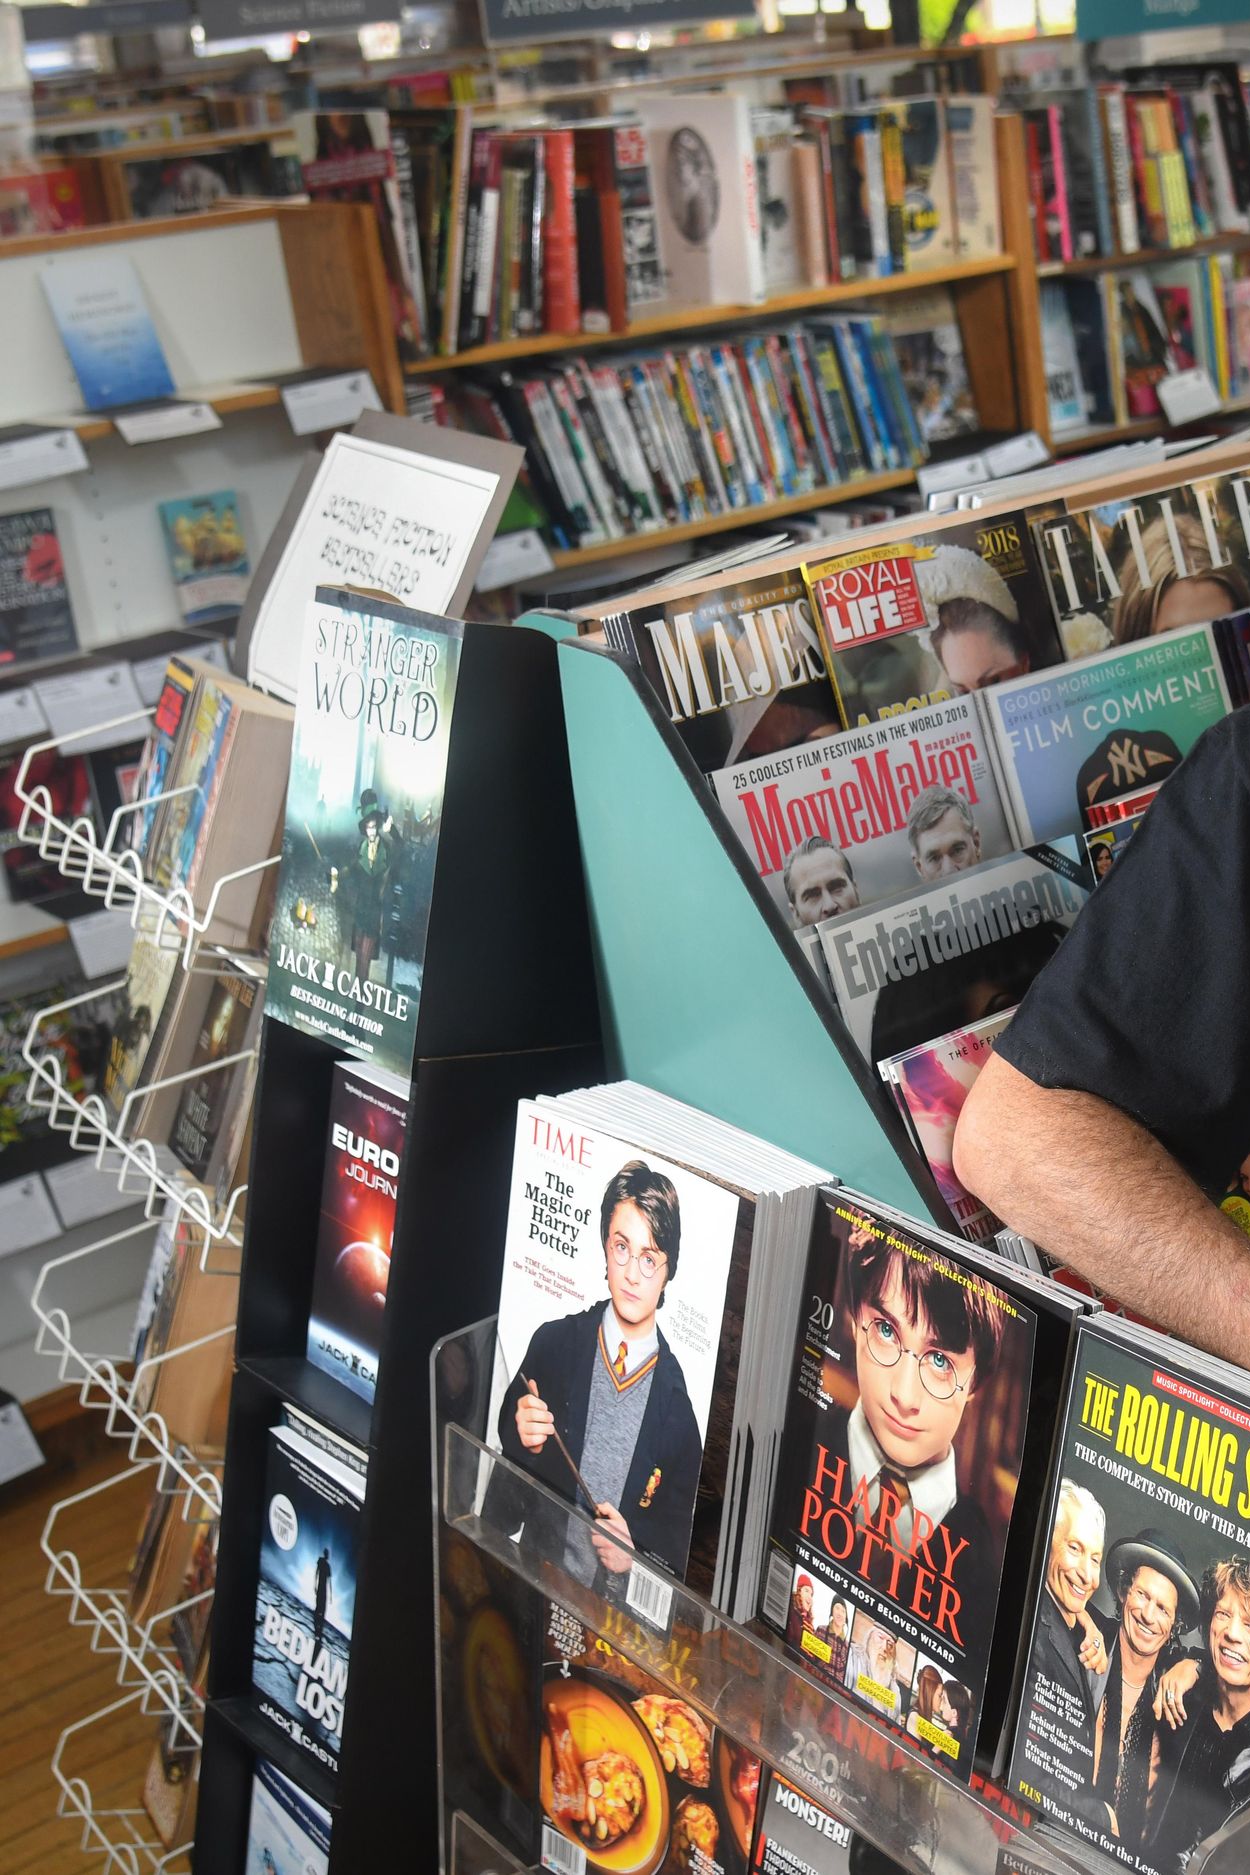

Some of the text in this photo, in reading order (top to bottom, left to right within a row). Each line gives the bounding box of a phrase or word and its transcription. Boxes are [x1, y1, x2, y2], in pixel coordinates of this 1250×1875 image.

[976, 527, 1021, 558] 2018
[817, 557, 912, 606] ROYAL
[825, 590, 904, 644] LIFE
[315, 618, 437, 688] STRANGER
[314, 662, 438, 742] WORLD
[1004, 686, 1051, 714] GOOD
[1005, 714, 1074, 753] FILM
[1083, 665, 1217, 732] COMMENT
[1008, 712, 1035, 727] SPIKE
[732, 704, 969, 791] 25 COOLEST FILM FESTIVALS IN THE WORLD 2018
[924, 731, 973, 753] magazine
[738, 741, 981, 878] MovieMaker
[833, 869, 1079, 999] Entertainment
[276, 943, 410, 1022] JACK CASTLE
[347, 1008, 384, 1037] AUTHOR
[948, 1045, 969, 1062] THE
[528, 1114, 595, 1169] TIME
[545, 1170, 575, 1200] The
[524, 1182, 593, 1227] Magic of
[531, 1203, 580, 1242] Harry
[528, 1222, 579, 1260] Potter
[541, 1261, 557, 1277] Goes
[835, 1206, 1019, 1319] ANNIVERSARY COLLECTOR'S EDITION
[807, 1322, 823, 1338] Years
[808, 1294, 834, 1331] 20
[318, 1338, 349, 1366] JACK
[805, 1331, 842, 1362] Enchantment
[800, 1367, 818, 1385] Guide
[817, 1385, 834, 1404] Books
[1155, 1375, 1178, 1392] MUSIC
[808, 1390, 829, 1412] Movies
[1081, 1376, 1119, 1437] THE
[1115, 1383, 1240, 1511] ROLLING
[1074, 1441, 1098, 1467] THE
[1097, 1455, 1157, 1498] COMPLETE
[1155, 1485, 1195, 1515] STORY
[1193, 1504, 1212, 1525] OF
[1211, 1512, 1236, 1539] THE
[812, 1443, 971, 1584] HARRY
[799, 1487, 965, 1648] POTTER
[551, 1611, 585, 1634] BACON
[795, 1543, 956, 1665] THE WORLD'S MOST BELOVED WIZARD
[547, 1629, 587, 1654] POTATO
[553, 1640, 581, 1657] SOUP
[856, 1683, 896, 1711] CHARACTERS
[858, 1674, 897, 1702] MEMORABLE
[1034, 1681, 1087, 1723] Guide to Every
[1036, 1671, 1084, 1709] The Ultimate
[259, 1702, 292, 1732] JACK
[1032, 1693, 1085, 1730] Album & Tour
[1028, 1721, 1074, 1756] in the Studio
[1029, 1709, 1095, 1759] Behind the Scenes
[1023, 1749, 1079, 1792] With the Group
[1025, 1738, 1086, 1785] Private Moments
[775, 1783, 852, 1849] MONSTER!
[1018, 1780, 1135, 1867] PLUS What's Next for the
